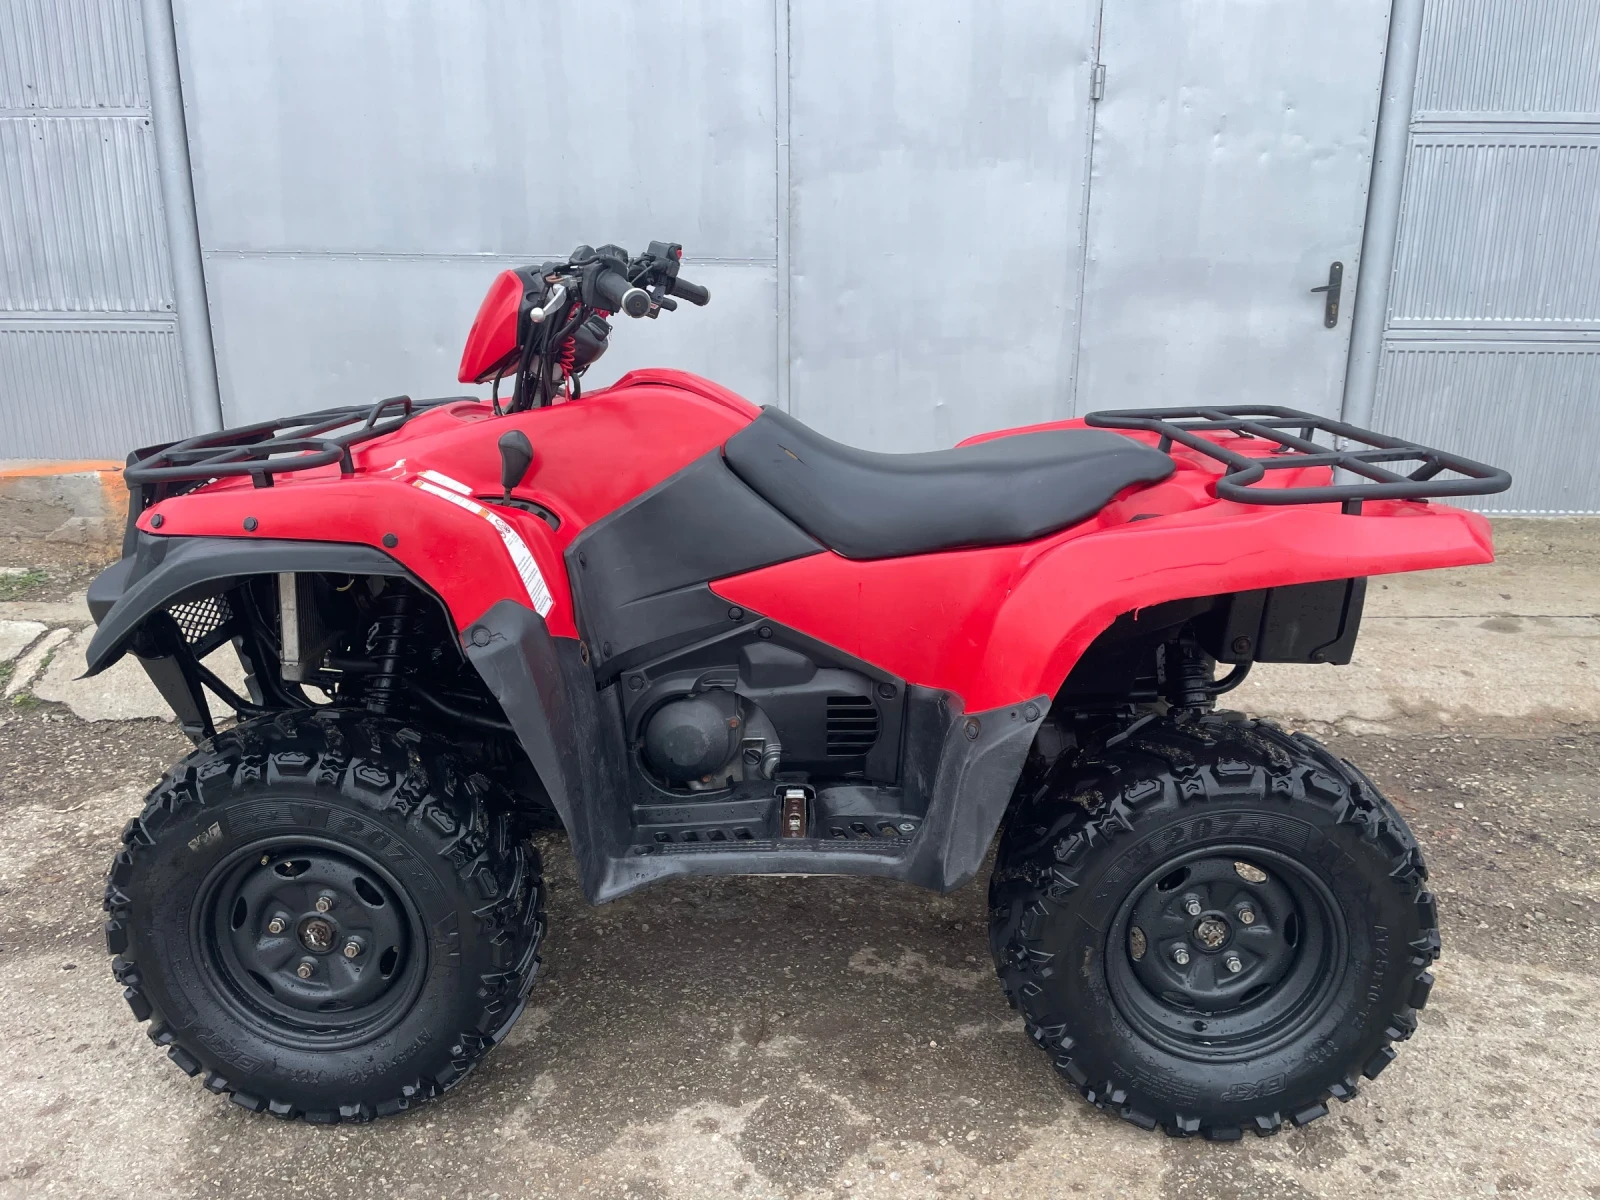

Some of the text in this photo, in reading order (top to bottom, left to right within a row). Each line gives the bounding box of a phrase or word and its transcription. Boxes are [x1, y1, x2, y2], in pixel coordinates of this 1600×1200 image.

[337, 816, 414, 862] 207
[1163, 814, 1242, 852] 207
[197, 1034, 264, 1075] BKT
[1220, 1072, 1287, 1102] BKT
